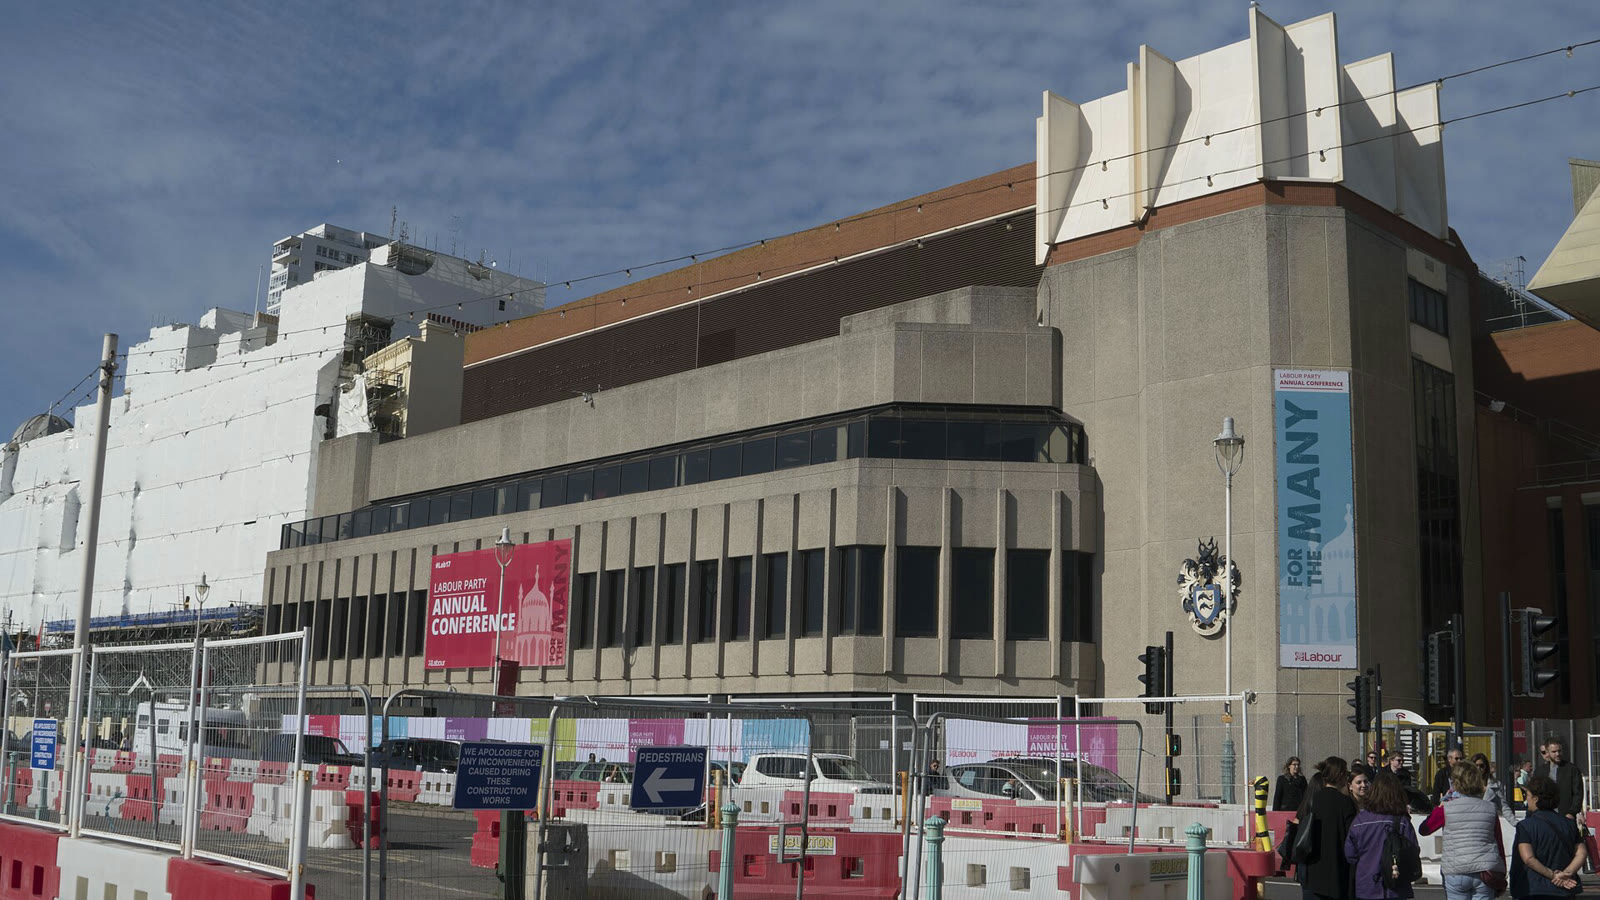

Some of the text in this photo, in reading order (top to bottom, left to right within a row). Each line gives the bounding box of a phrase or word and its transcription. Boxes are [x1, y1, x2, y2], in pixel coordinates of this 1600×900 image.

[1284, 399, 1321, 543] MANY
[1287, 548, 1303, 587] FOR
[1307, 550, 1322, 587] THE
[434, 577, 487, 593] LABOUR PARTY
[551, 544, 569, 634] MANY
[432, 594, 488, 616] ANNUAL
[431, 612, 516, 636] CONFERENCE
[556, 637, 564, 662] THE
[1304, 651, 1342, 662] Labour
[464, 748, 540, 758] WE APOLOGISE FOR
[639, 752, 704, 763] PEDESTRIANS
[460, 758, 541, 767] ANY INCONVENIENCE
[468, 767, 531, 776] CAUSED DURING
[486, 777, 511, 785] THESE
[466, 786, 528, 795] CONSTRUCTION
[482, 796, 511, 805] WORKS
